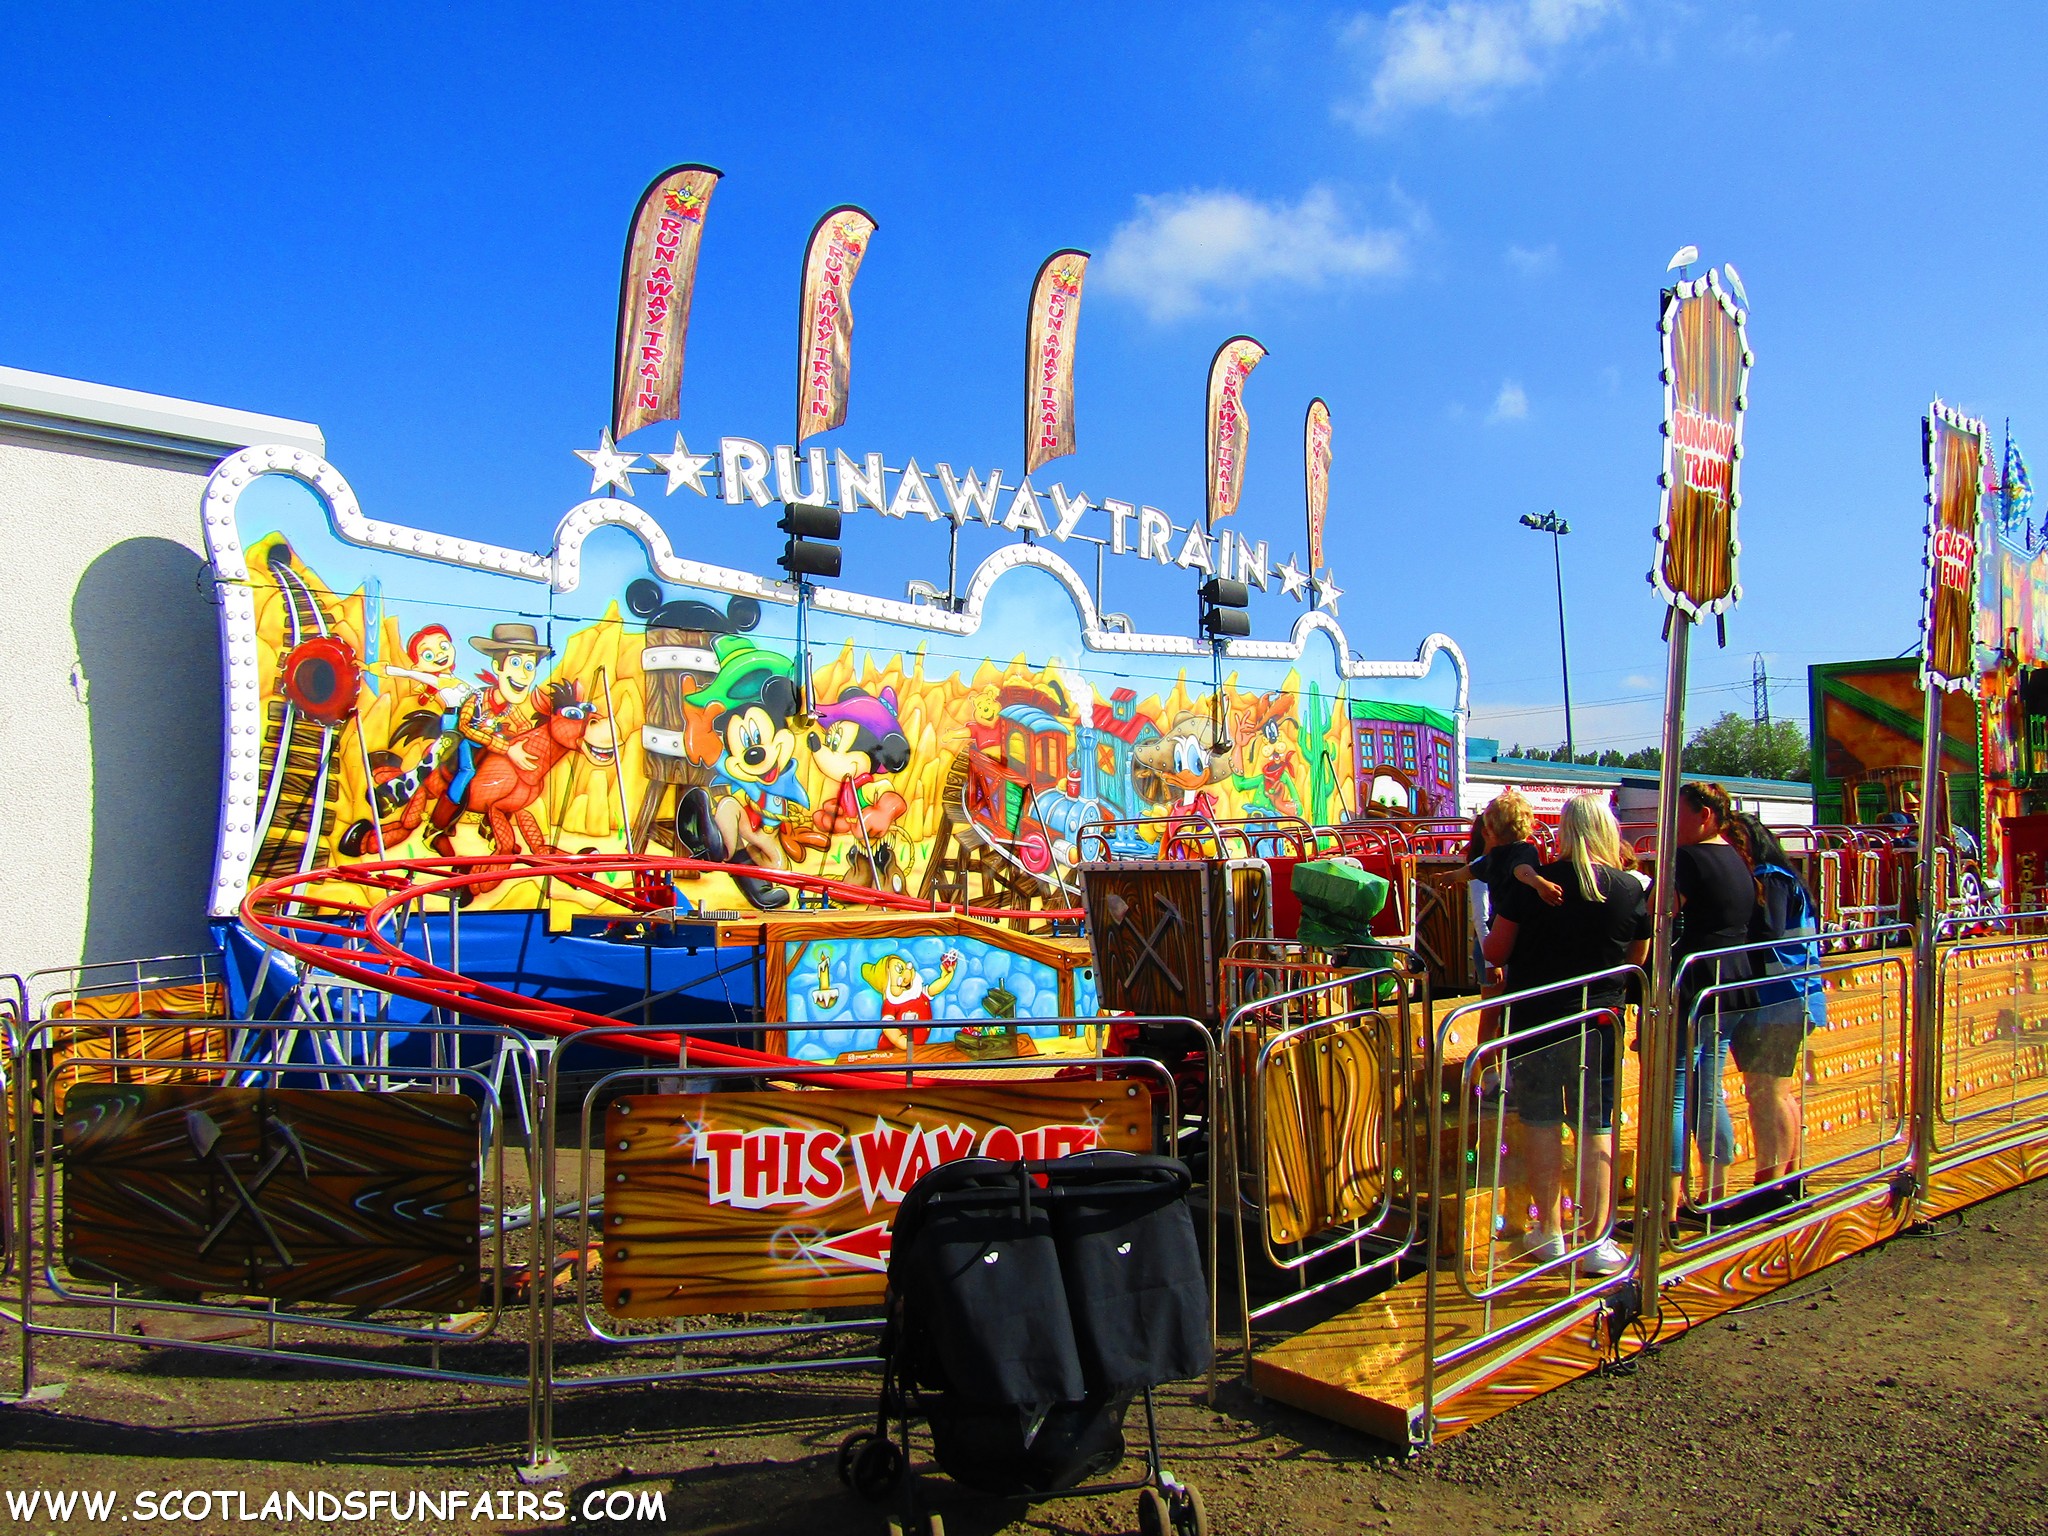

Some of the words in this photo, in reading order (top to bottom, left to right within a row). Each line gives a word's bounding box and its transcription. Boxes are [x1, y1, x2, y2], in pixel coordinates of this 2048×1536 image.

[638, 331, 664, 410] TRAIN
[812, 347, 832, 418] TRAIN
[1040, 387, 1058, 448] TRAIN
[1673, 408, 1735, 463] RUNAWAY
[1218, 446, 1232, 504] TRAIN
[1684, 451, 1724, 493] TRAIN
[720, 435, 1090, 543] RUNAWAY
[1104, 497, 1269, 593] TRAIN
[1934, 529, 1974, 569] CRAZY
[1940, 560, 1968, 593] FUN
[697, 1126, 846, 1210] THIS
[851, 1115, 977, 1213] WAY
